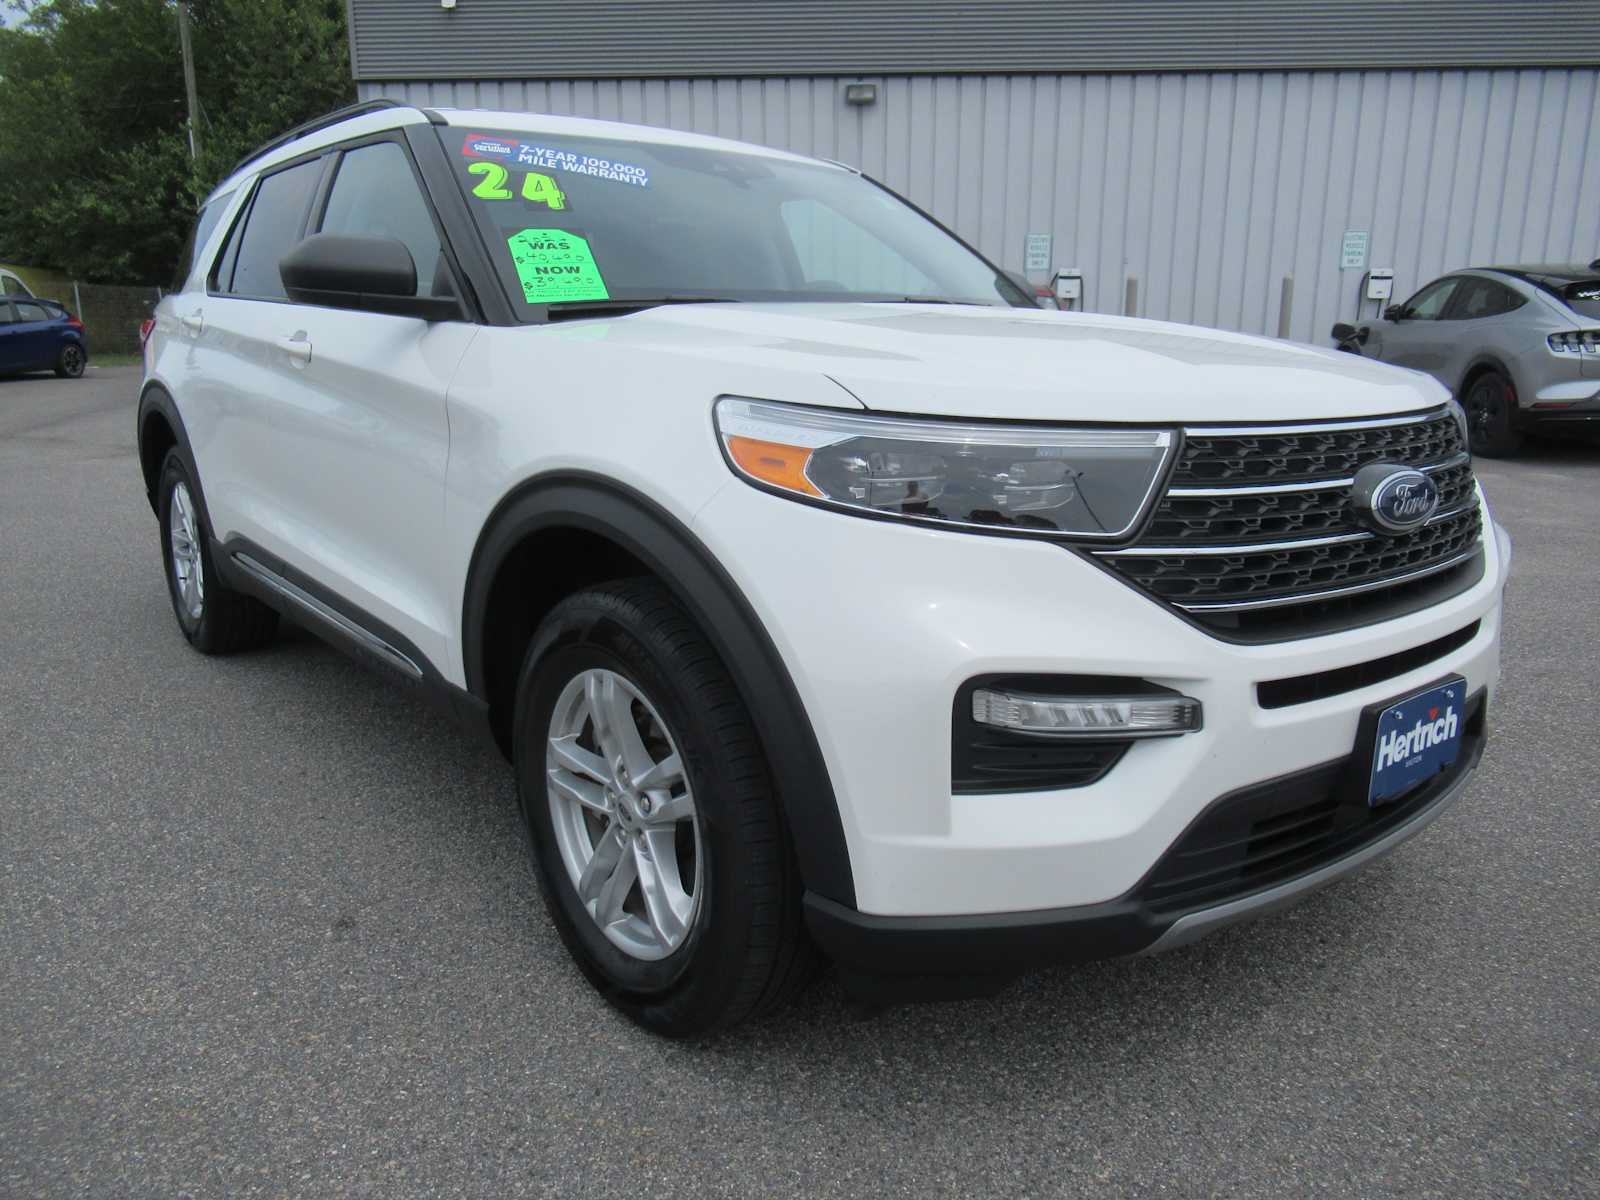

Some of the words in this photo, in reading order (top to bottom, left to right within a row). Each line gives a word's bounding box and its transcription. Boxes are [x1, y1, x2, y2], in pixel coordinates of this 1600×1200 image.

[519, 144, 577, 163] 7-YEAR
[518, 153, 557, 168] MILE
[562, 162, 649, 187] WARRANTY
[527, 242, 571, 250] WAS
[535, 266, 581, 275] NOW
[1394, 483, 1432, 515] Ford
[1376, 706, 1458, 772] Hertrich
